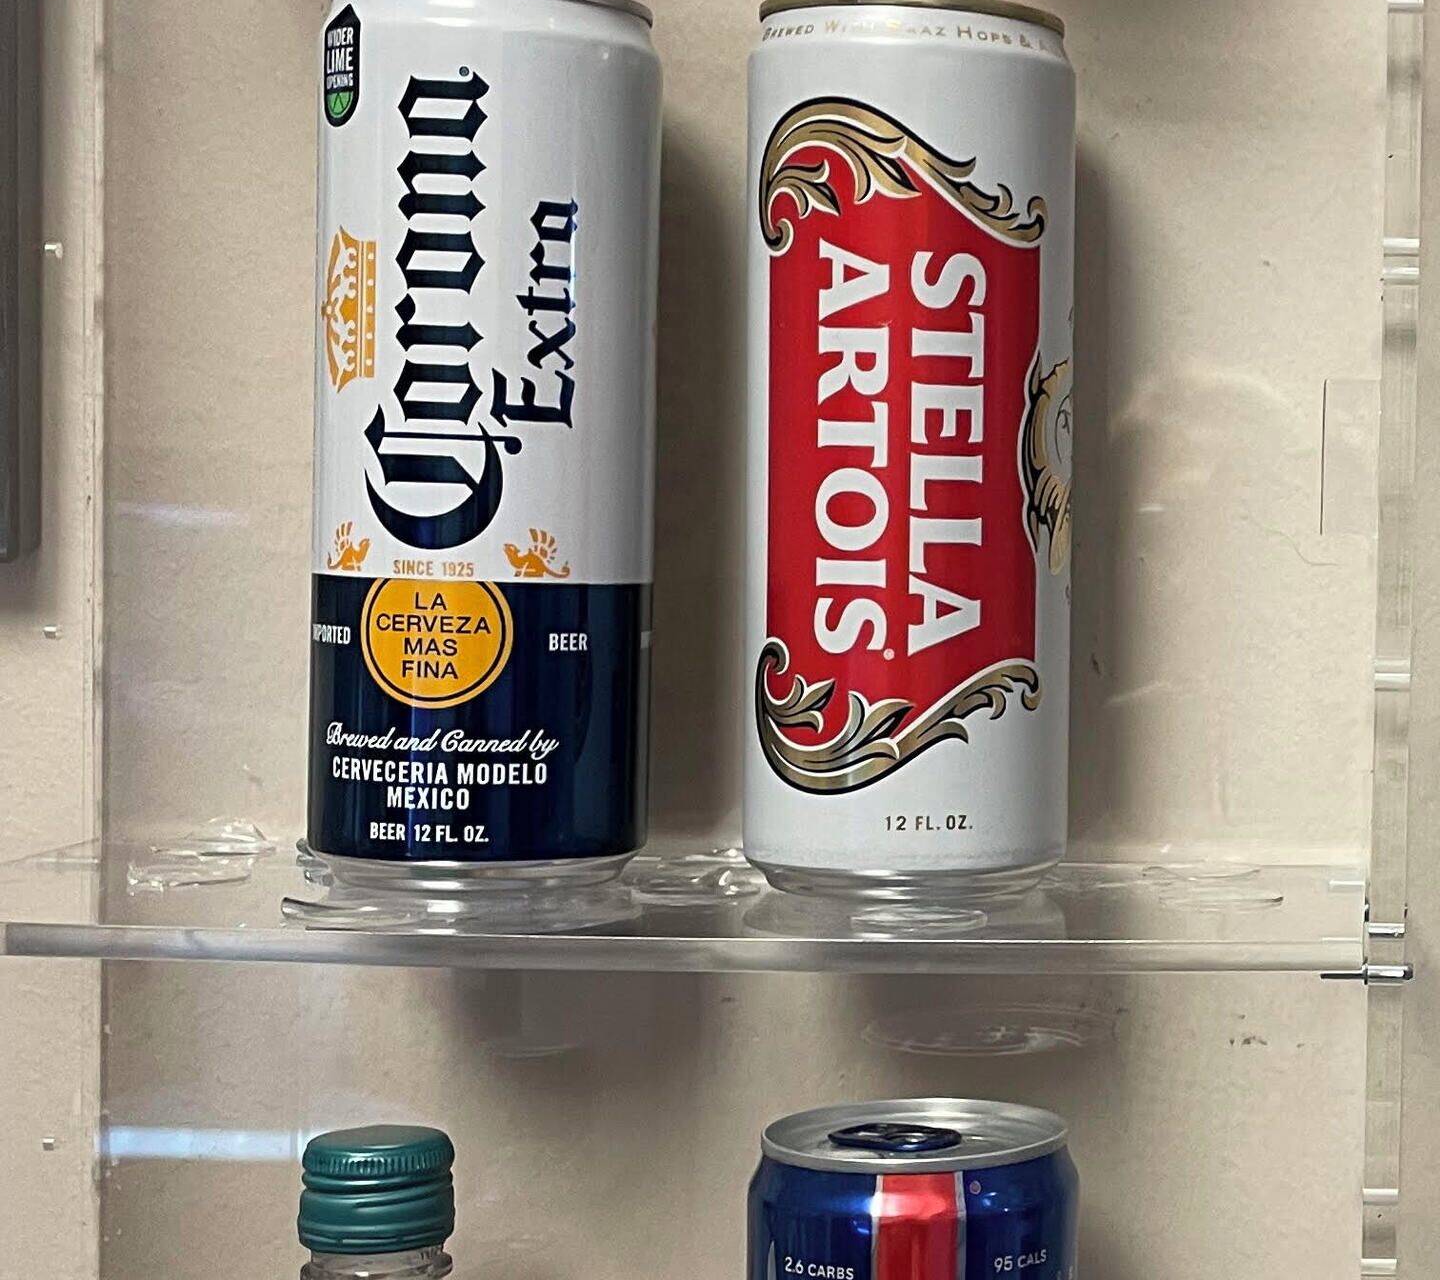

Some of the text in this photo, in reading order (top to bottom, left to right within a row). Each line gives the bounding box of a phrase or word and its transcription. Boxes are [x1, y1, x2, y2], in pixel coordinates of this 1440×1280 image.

[326, 47, 354, 74] LIME
[364, 71, 522, 551] Corona
[490, 197, 578, 429] Extra
[813, 238, 891, 654] ARTOIS
[908, 251, 987, 657] STELLA
[392, 560, 475, 578] SINCE 1925
[414, 591, 447, 612] LA
[376, 613, 492, 635] CERVEZA
[403, 638, 459, 657] MAS
[548, 633, 589, 652] BEER
[401, 659, 459, 680] FINA
[326, 721, 559, 761] Brewed and Canned by
[332, 756, 548, 785] CERVECERIA MODELO
[386, 786, 471, 810] MEXICO
[369, 821, 490, 843] BEER 12 FL. OZ.
[884, 814, 974, 831] 12 FL. OZ.
[784, 1255, 804, 1275] 2.6
[993, 1249, 1048, 1273] 95 CALS
